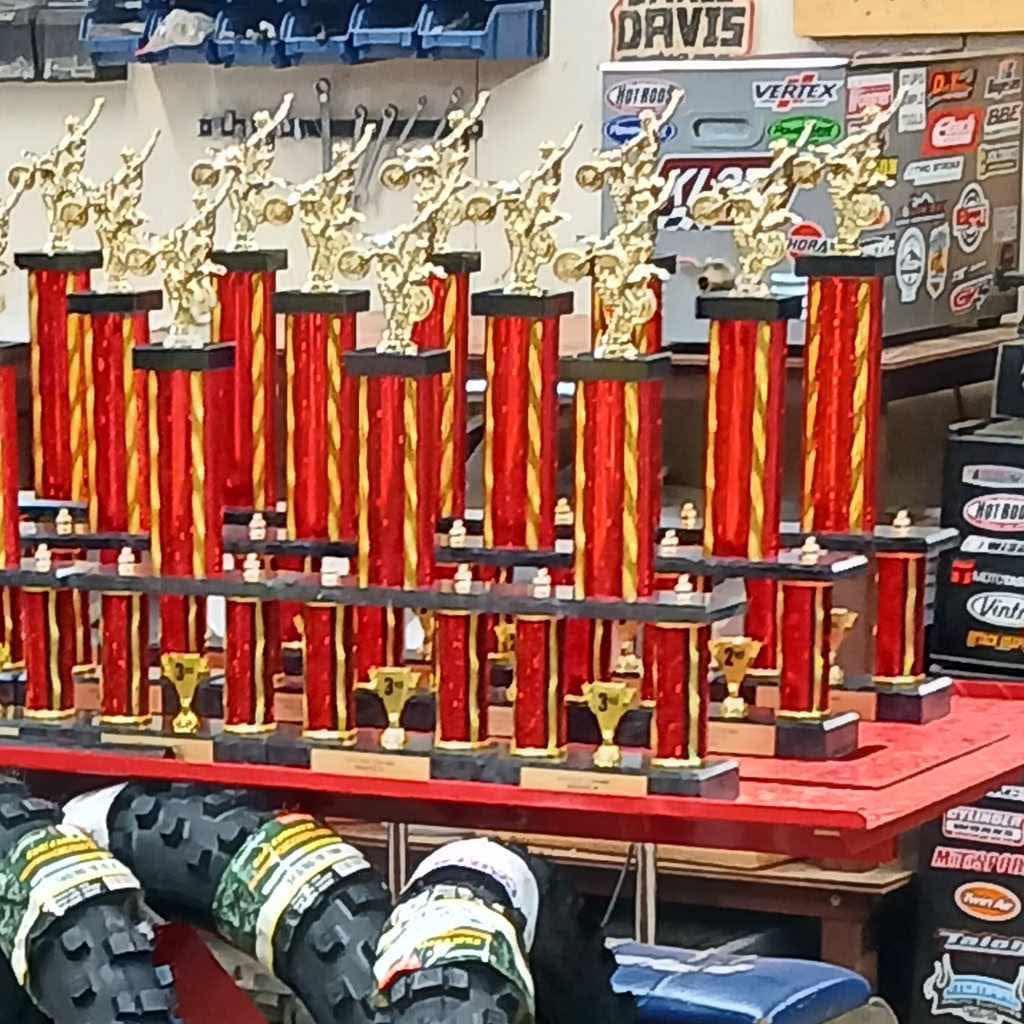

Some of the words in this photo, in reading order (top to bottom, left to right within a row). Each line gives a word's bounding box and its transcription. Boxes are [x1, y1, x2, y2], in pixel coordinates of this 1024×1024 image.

[617, 6, 747, 50] DAVIS
[755, 83, 837, 99] VERTEX
[786, 238, 828, 253] HORA
